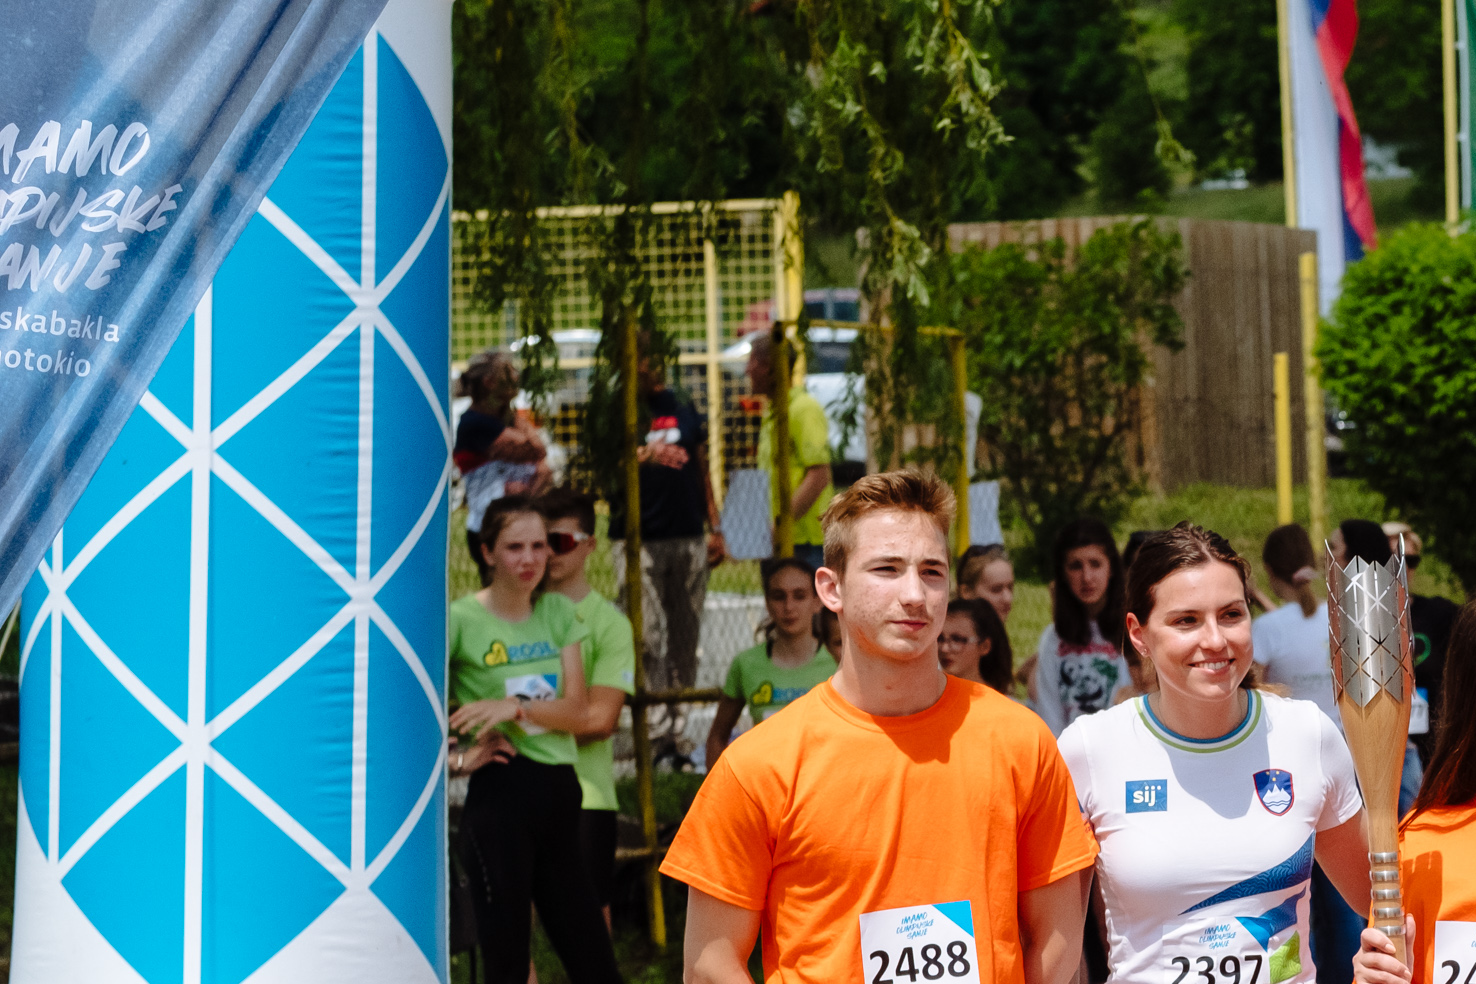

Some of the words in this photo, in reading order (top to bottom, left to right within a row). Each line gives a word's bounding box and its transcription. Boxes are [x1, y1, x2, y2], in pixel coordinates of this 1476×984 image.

[0, 184, 183, 237] PIJSKE
[0, 306, 120, 342] skabakla
[1132, 785, 1159, 807] sij
[901, 911, 928, 925] IMAMO
